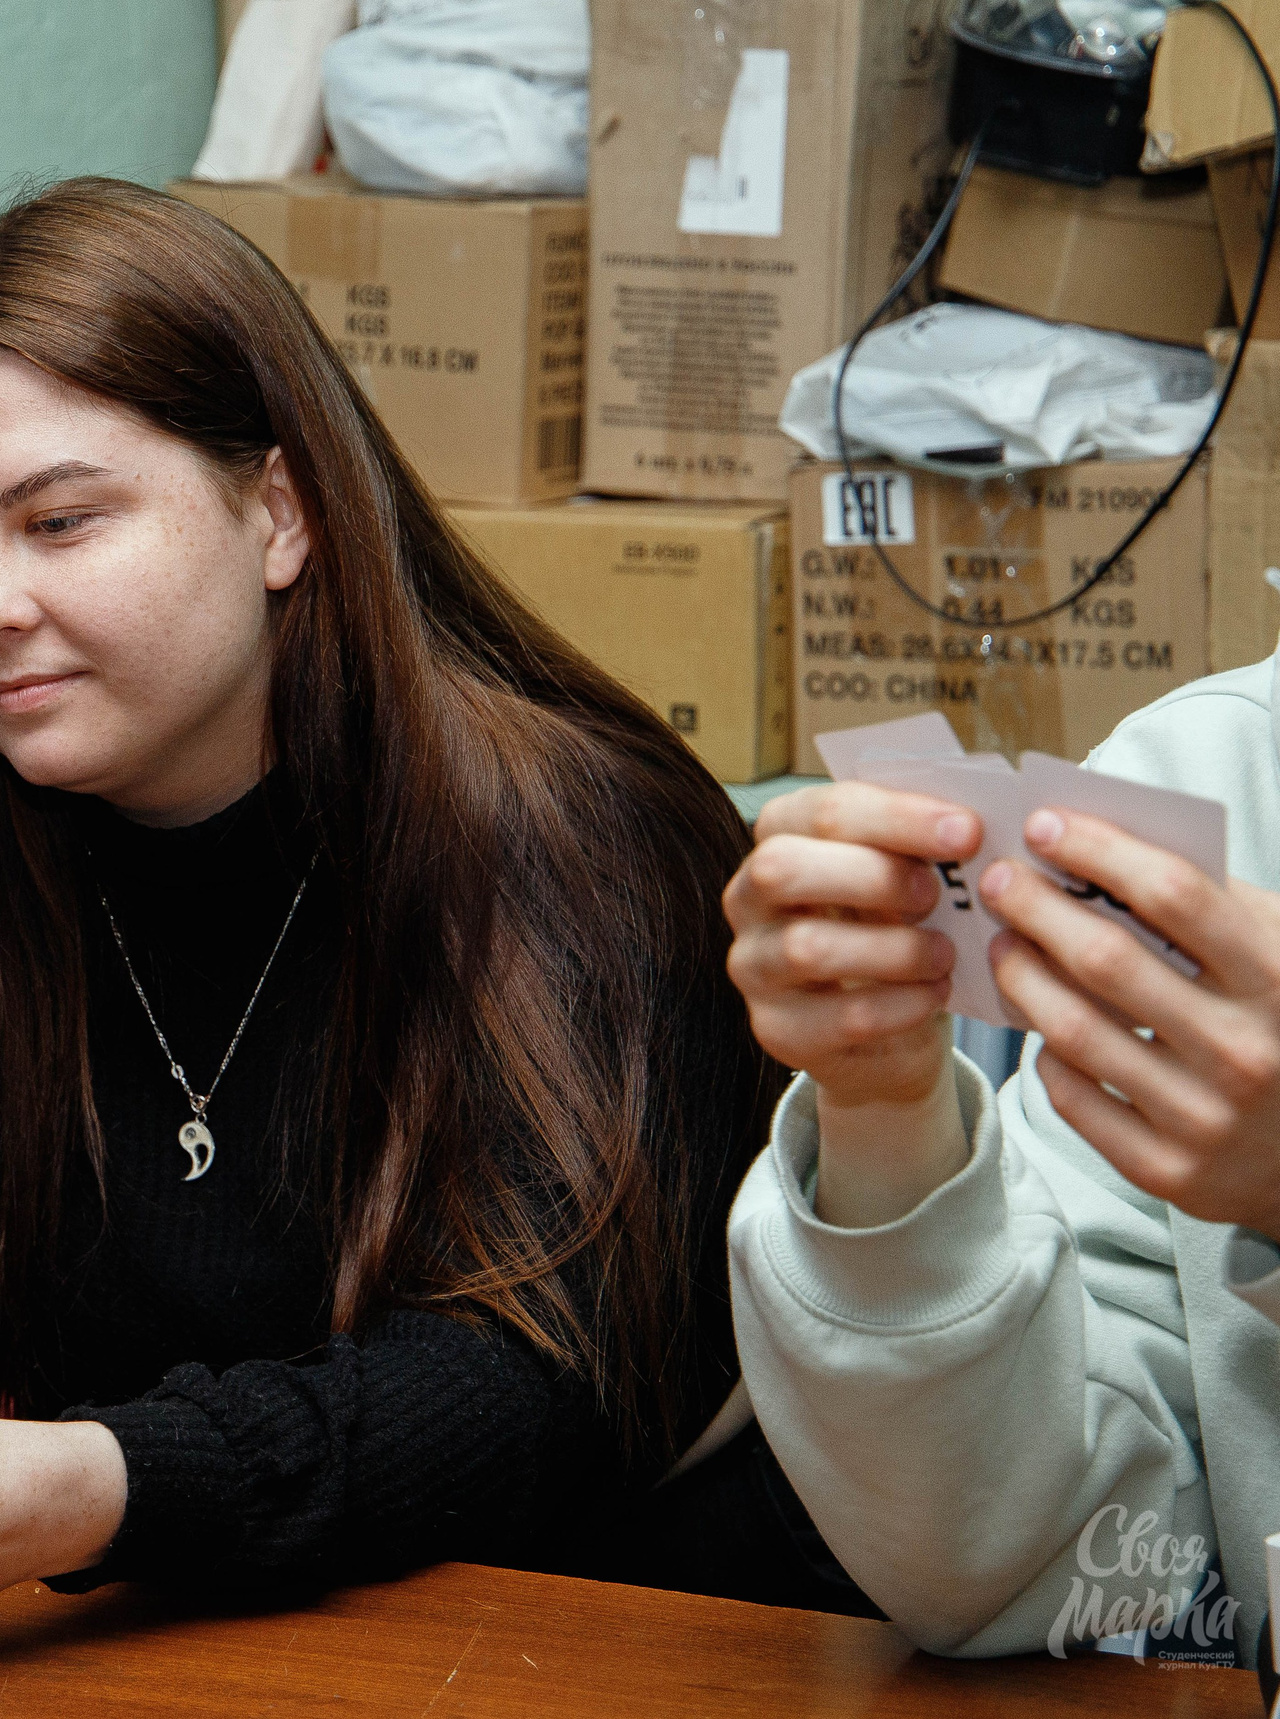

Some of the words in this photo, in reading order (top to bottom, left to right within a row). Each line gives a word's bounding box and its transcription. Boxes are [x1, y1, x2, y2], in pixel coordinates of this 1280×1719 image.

[347, 284, 389, 309] KGS
[345, 312, 387, 338] KGS
[445, 349, 479, 374] CM
[1070, 597, 1136, 629] KGS
[1121, 640, 1173, 670] CM
[884, 673, 979, 705] CHINA
